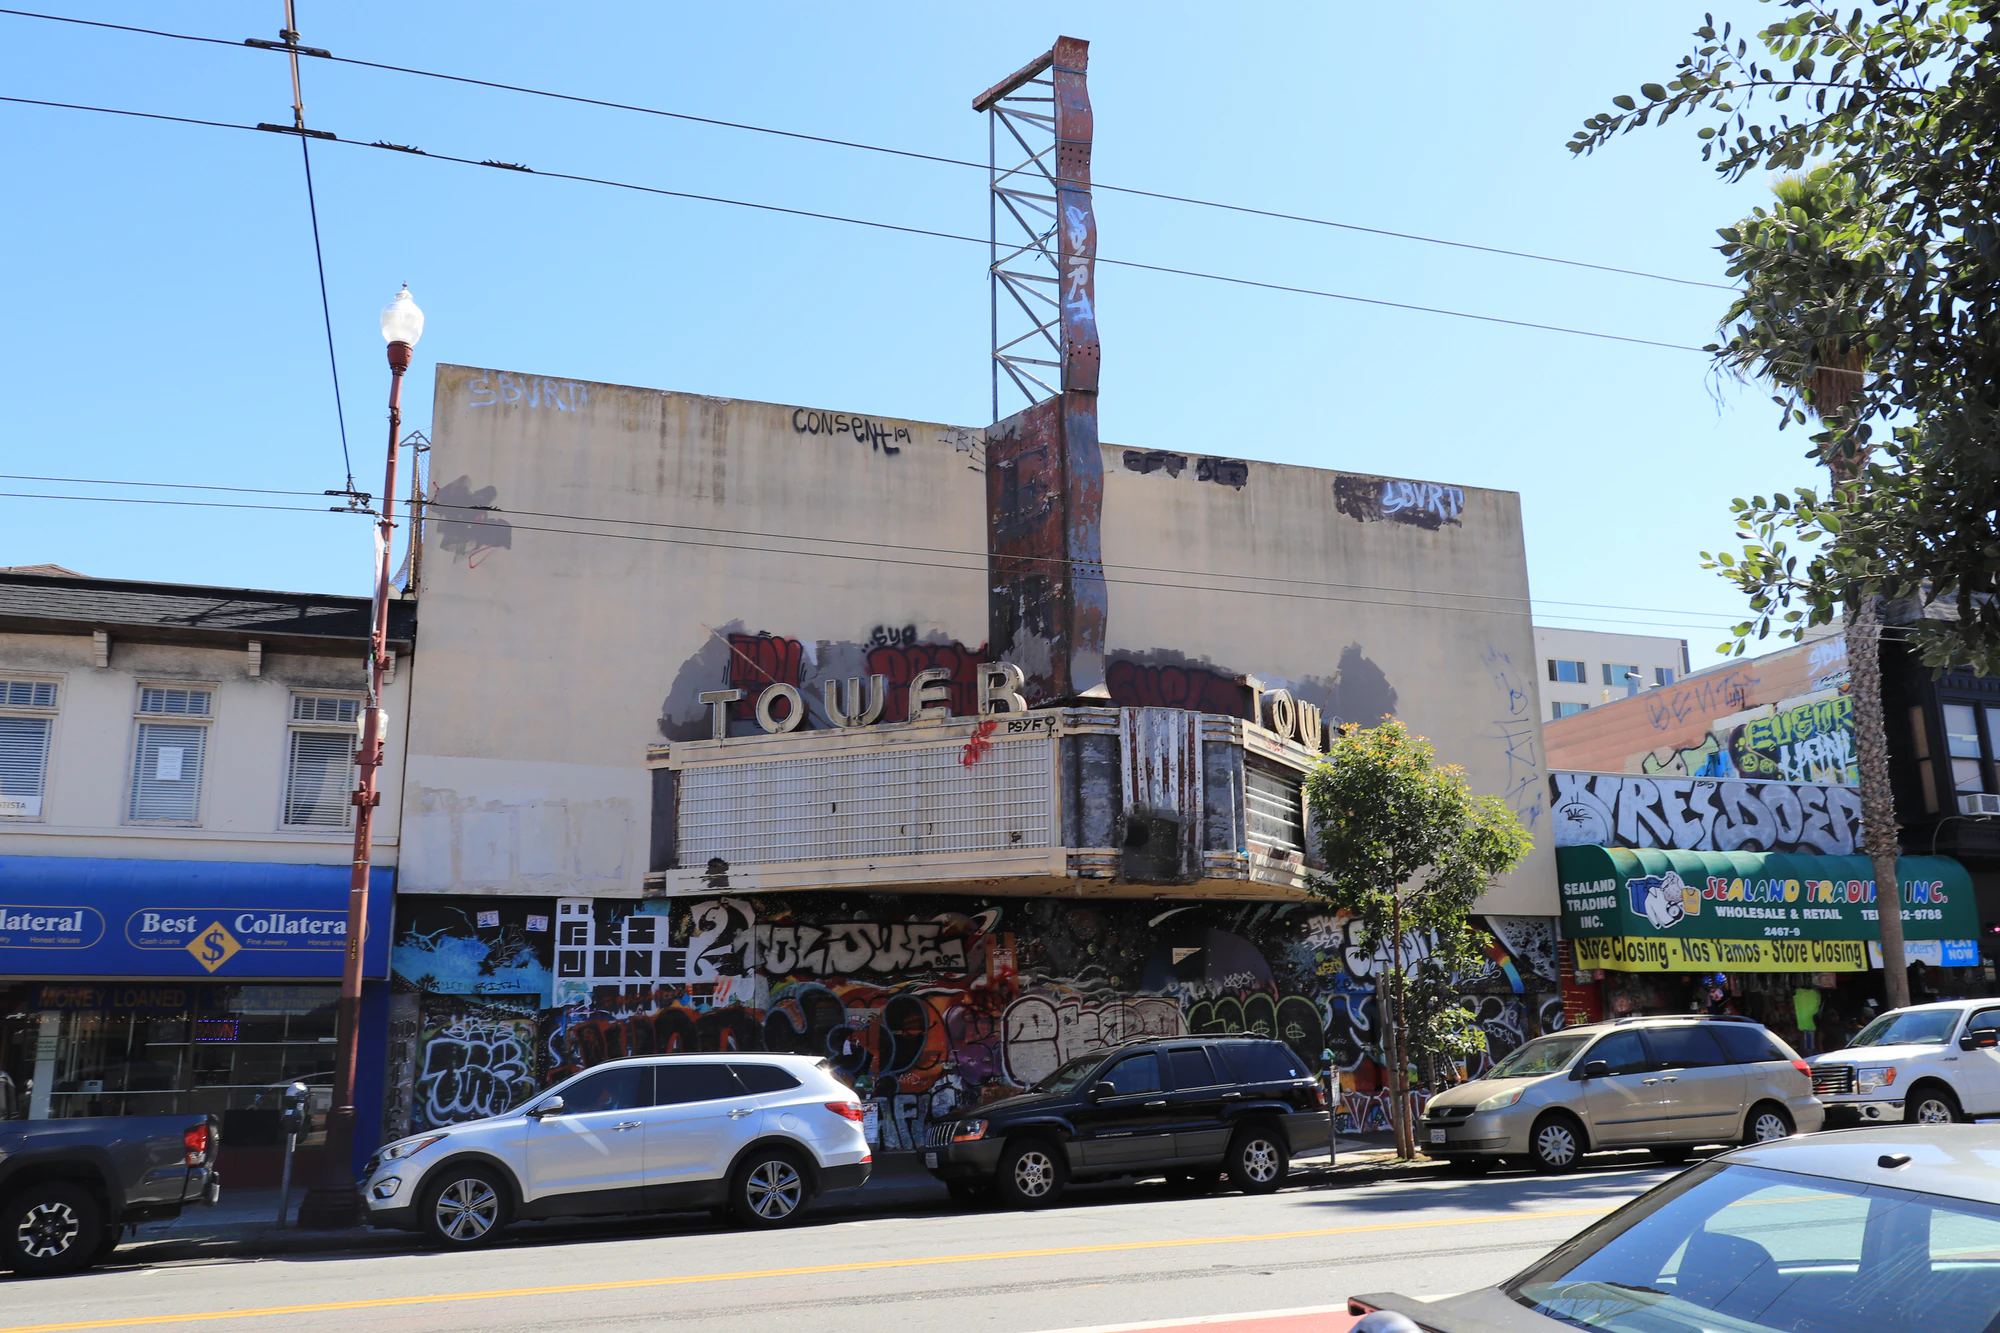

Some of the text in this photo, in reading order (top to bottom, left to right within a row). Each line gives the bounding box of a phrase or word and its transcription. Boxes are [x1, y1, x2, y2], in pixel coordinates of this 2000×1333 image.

[699, 662, 1028, 741] TOWER
[1236, 673, 1350, 754] TOW
[1563, 878, 1616, 896] SEALAND
[1702, 876, 1800, 903] SEALAND
[1904, 880, 1948, 904] INC.
[1567, 896, 1616, 911] TRADING
[1715, 905, 1786, 919] WHOLESALE
[1790, 908, 1800, 919] &
[1803, 908, 1843, 920] RETAIL
[141, 913, 197, 933] Best
[235, 913, 348, 935] Collatera
[1580, 915, 1604, 928] INC.
[1764, 926, 1801, 936] 2467-9
[139, 937, 157, 945] Cash
[246, 938, 261, 946] Fine
[1612, 936, 1669, 969] Closing
[1681, 937, 1710, 962] Nos
[1711, 939, 1761, 963] Vamos
[1771, 940, 1808, 963] Store
[1811, 940, 1863, 969] Closing
[1949, 948, 1973, 960] NOW
